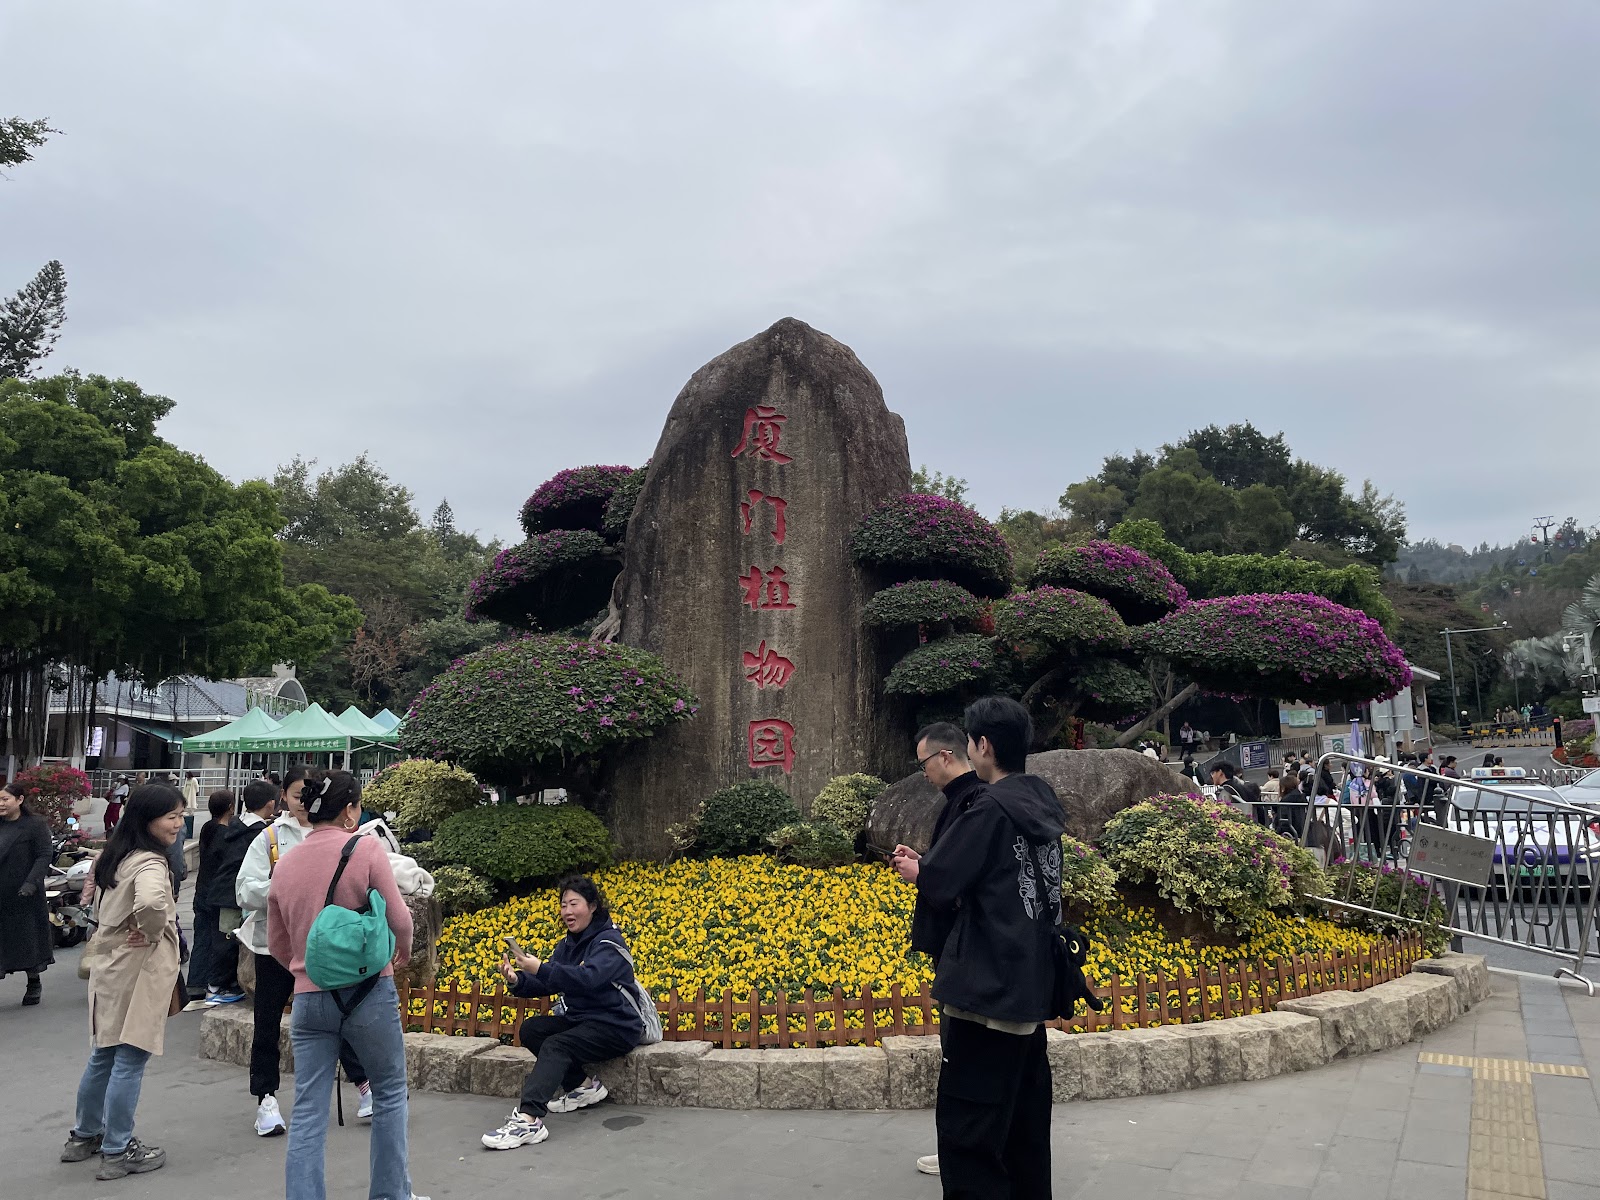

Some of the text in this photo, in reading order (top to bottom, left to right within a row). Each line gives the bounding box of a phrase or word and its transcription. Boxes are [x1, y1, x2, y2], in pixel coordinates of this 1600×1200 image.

[731, 405, 796, 773] 厦门植物园
